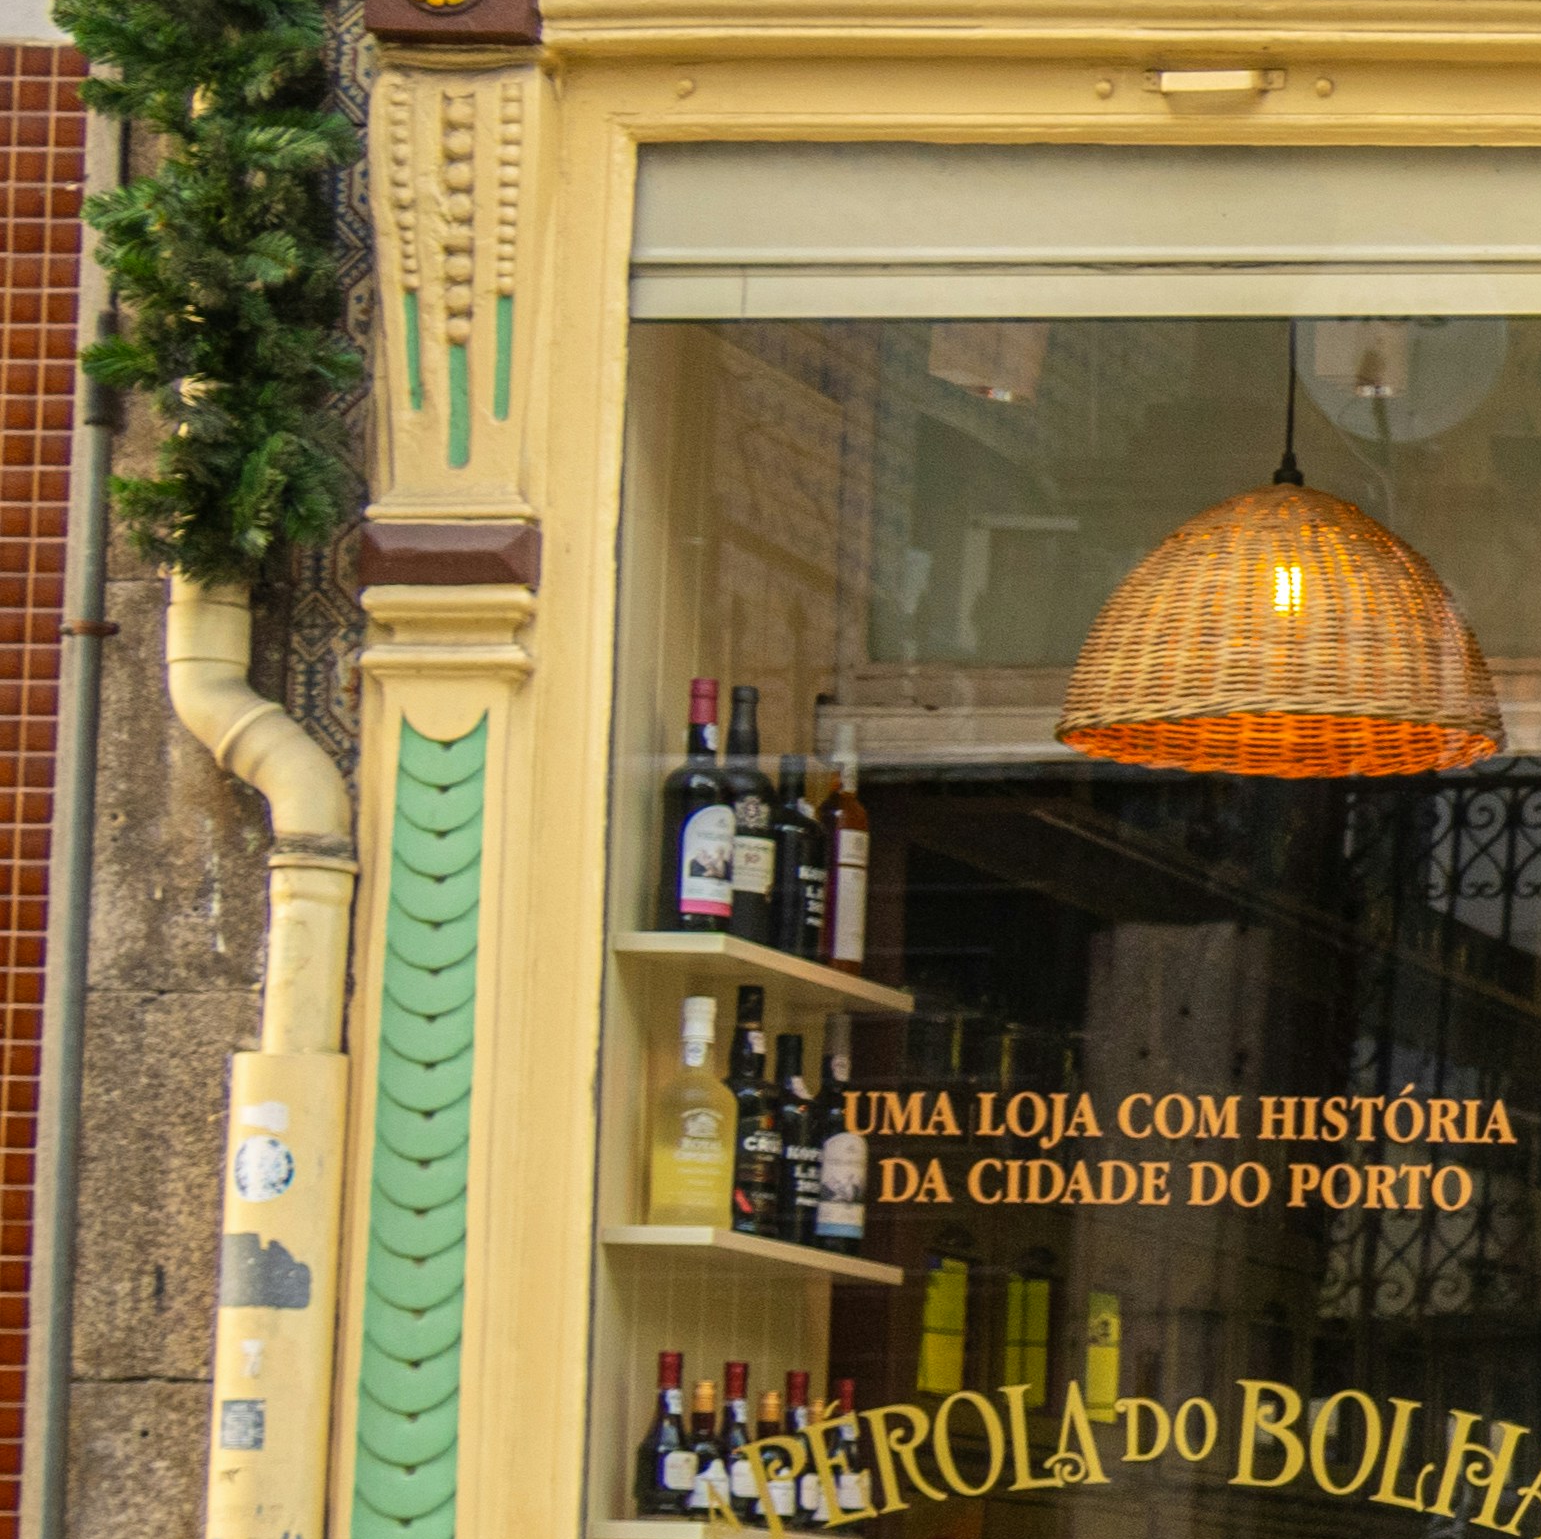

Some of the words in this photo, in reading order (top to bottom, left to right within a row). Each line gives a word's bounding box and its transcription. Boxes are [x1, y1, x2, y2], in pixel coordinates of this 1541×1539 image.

[842, 1090, 962, 1137] UMA
[974, 1091, 1103, 1150] LOJA
[1116, 1092, 1241, 1140] COM
[1257, 1083, 1518, 1144] HISTÓRIA
[877, 1157, 953, 1203] DA
[966, 1158, 1171, 1206] CIDADE
[1187, 1160, 1272, 1208] DO
[1287, 1163, 1474, 1212] PORTO
[1114, 1396, 1218, 1462] DO
